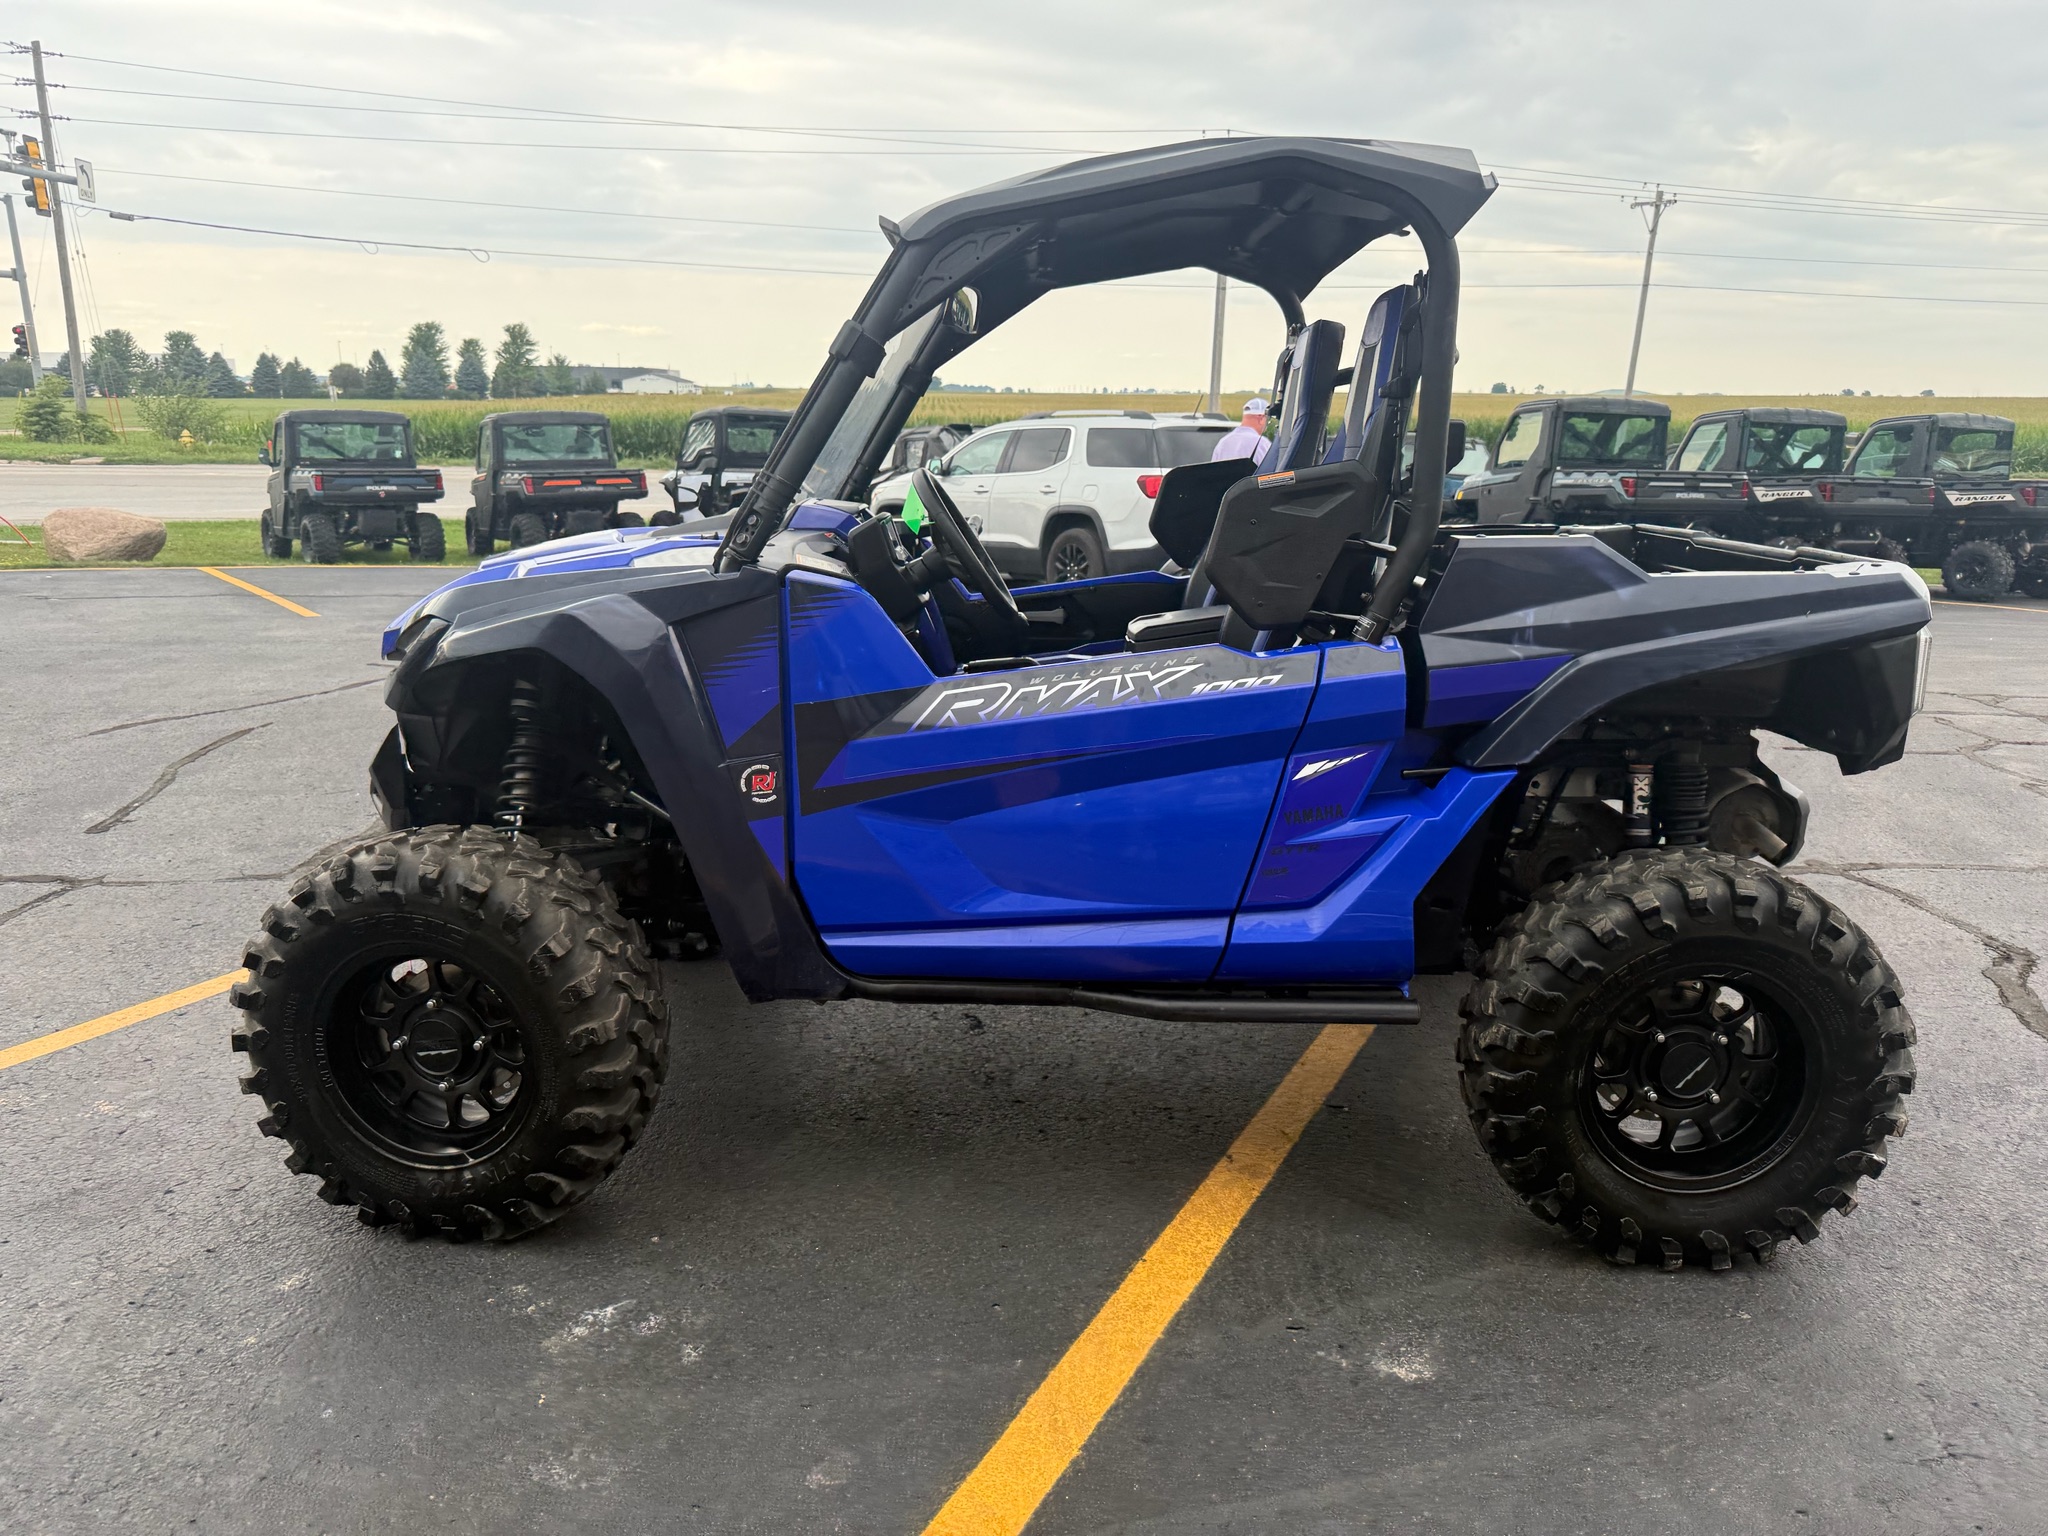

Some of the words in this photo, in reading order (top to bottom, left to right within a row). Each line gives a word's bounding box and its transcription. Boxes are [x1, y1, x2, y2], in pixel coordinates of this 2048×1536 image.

[80, 188, 93, 199] ONLY
[1761, 490, 1808, 499] RANGER
[1954, 494, 2007, 503] RANGER
[1029, 655, 1199, 684] WOLVERINE
[911, 663, 1204, 732] RMAX
[1190, 674, 1284, 696] 1000
[1632, 776, 1651, 815] FOX
[1284, 803, 1344, 825] YAMAHA
